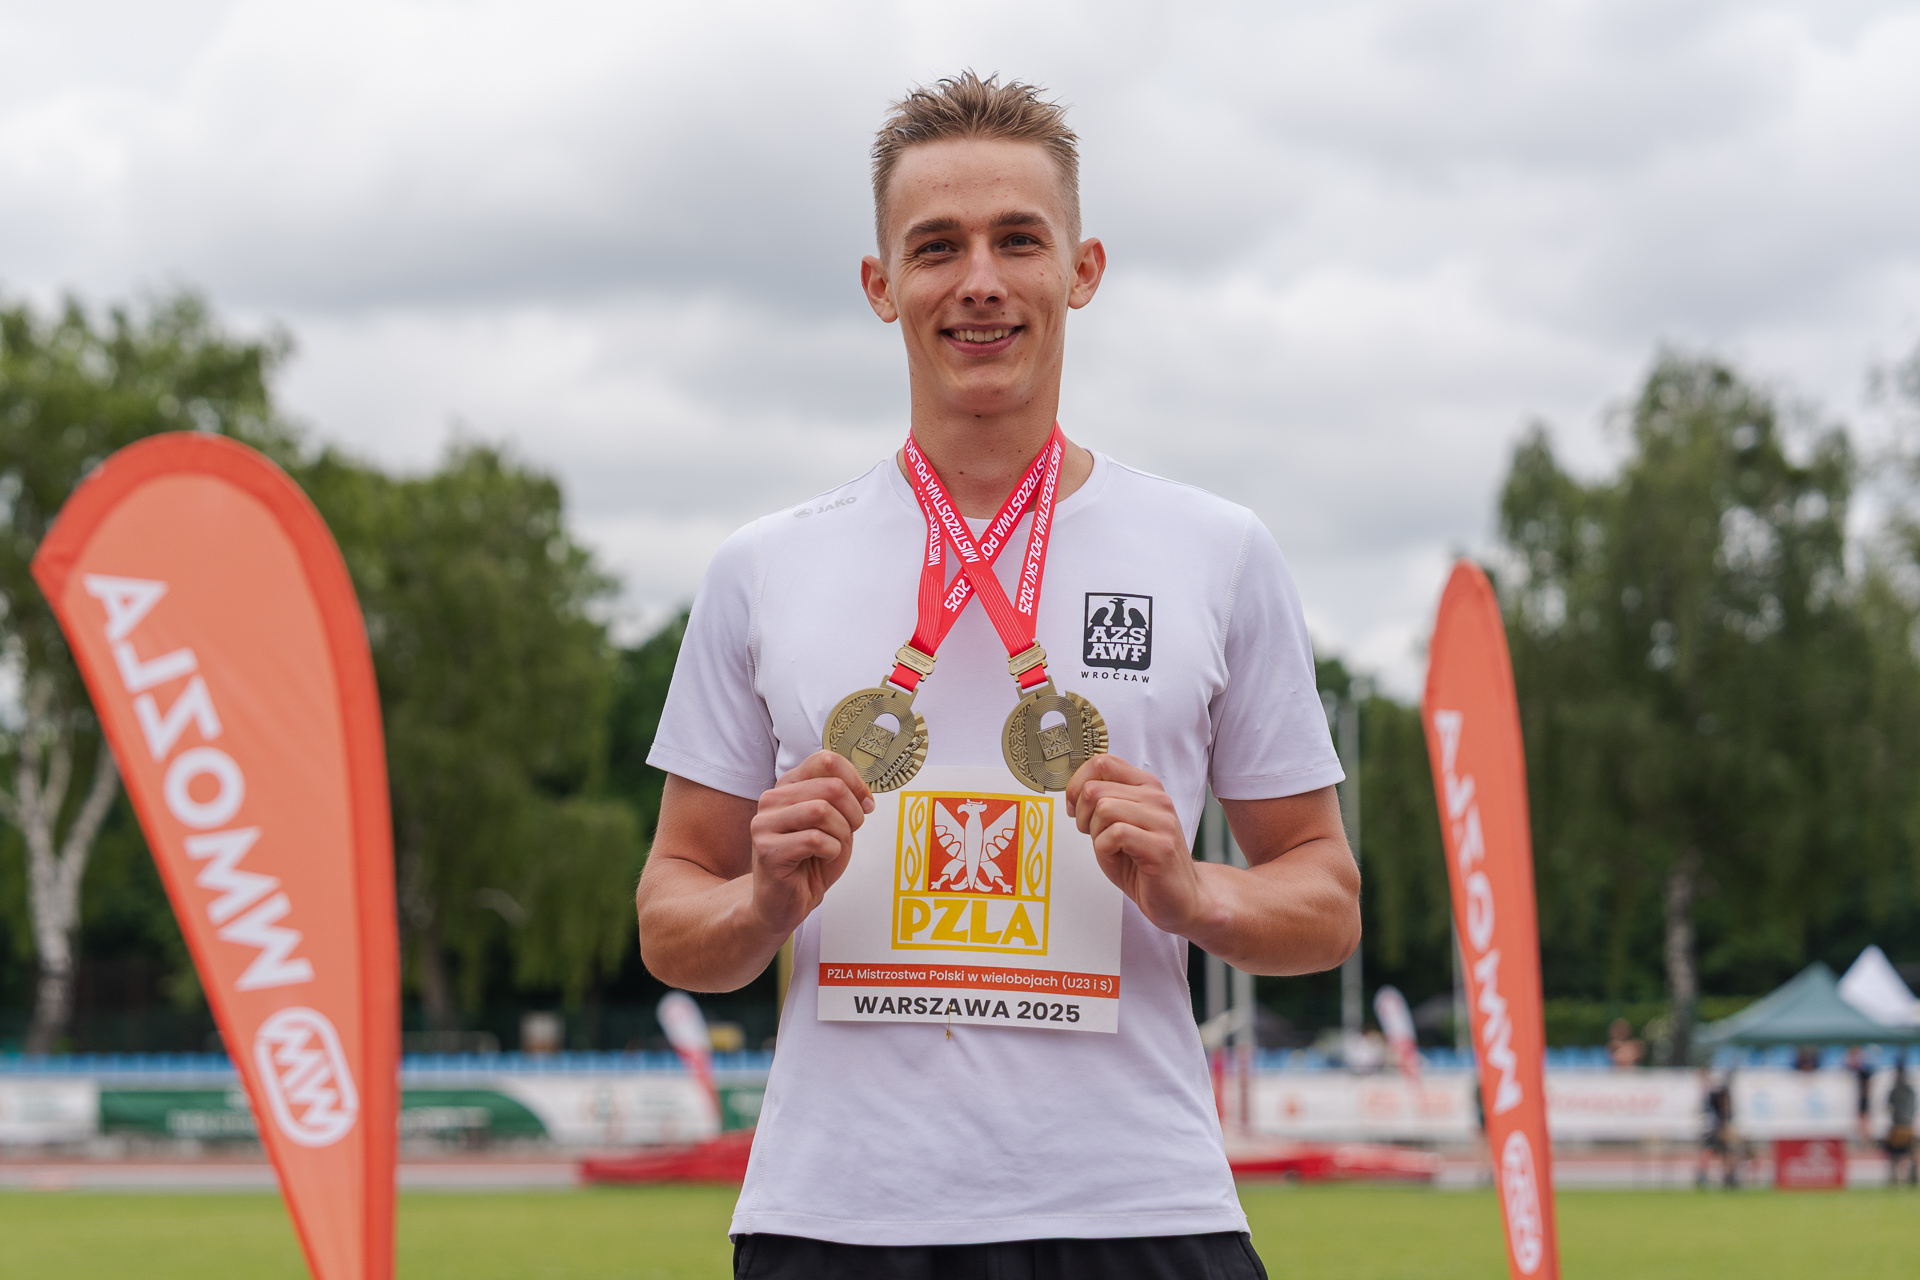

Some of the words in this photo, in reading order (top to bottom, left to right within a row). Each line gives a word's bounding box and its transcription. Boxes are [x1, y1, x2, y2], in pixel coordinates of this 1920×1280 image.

[905, 438, 932, 483] POLSKI
[816, 496, 857, 514] JAKO
[1034, 440, 1062, 536] MISTRZOSTWA
[925, 478, 981, 563] MISTRZOSTWA
[1024, 532, 1043, 585] POLSKI
[943, 578, 971, 613] 2025
[1018, 580, 1035, 616] 2025
[1087, 626, 1146, 645] AZS
[1087, 643, 1146, 662] AWF
[1081, 671, 1150, 684] WROCŁAW
[899, 898, 1039, 946] PZLA
[827, 968, 854, 979] PZLA
[856, 969, 926, 980] Mistrzostwa
[929, 970, 965, 981] Polski
[967, 973, 979, 982] w
[981, 972, 1058, 988] wielobojach
[1062, 974, 1090, 990] (U23
[1093, 979, 1097, 990] i
[1099, 978, 1113, 993] S)
[853, 996, 1010, 1019] WARSZAWA
[1016, 1001, 1081, 1023] 2025
